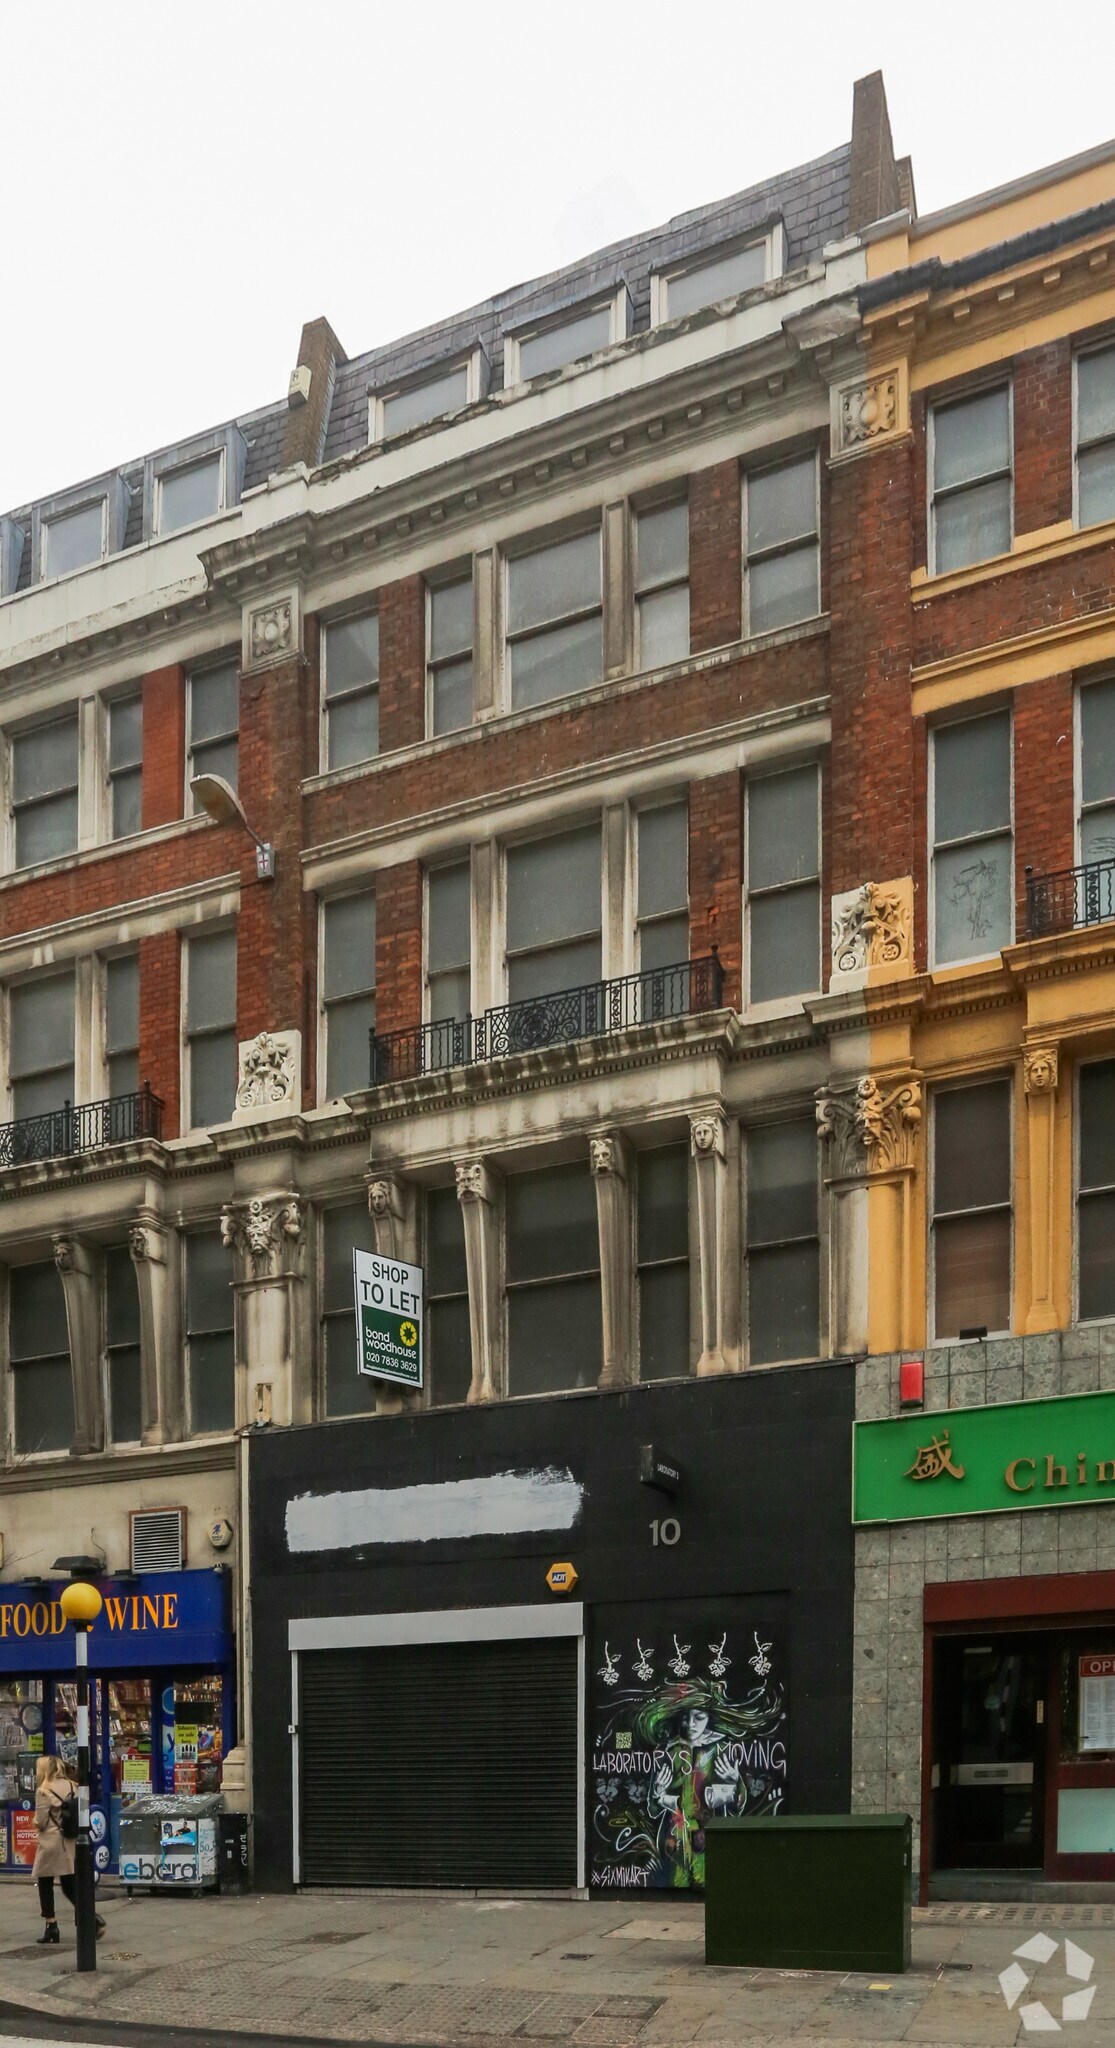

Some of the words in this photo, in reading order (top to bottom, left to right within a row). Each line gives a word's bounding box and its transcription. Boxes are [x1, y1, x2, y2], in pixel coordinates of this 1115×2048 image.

[372, 1261, 409, 1285] SHOP
[360, 1279, 384, 1304] TO
[390, 1288, 420, 1314] LET
[365, 1326, 390, 1342] bond
[365, 1338, 417, 1359] woodhouse
[366, 1351, 380, 1363] 020
[381, 1355, 399, 1368] 7836
[400, 1360, 417, 1373] 3629
[649, 1518, 681, 1546] 10
[552, 1573, 566, 1582] ADT
[0, 1602, 67, 1637] FOOD
[104, 1593, 178, 1631] WINE
[1090, 1661, 1115, 1673] OP
